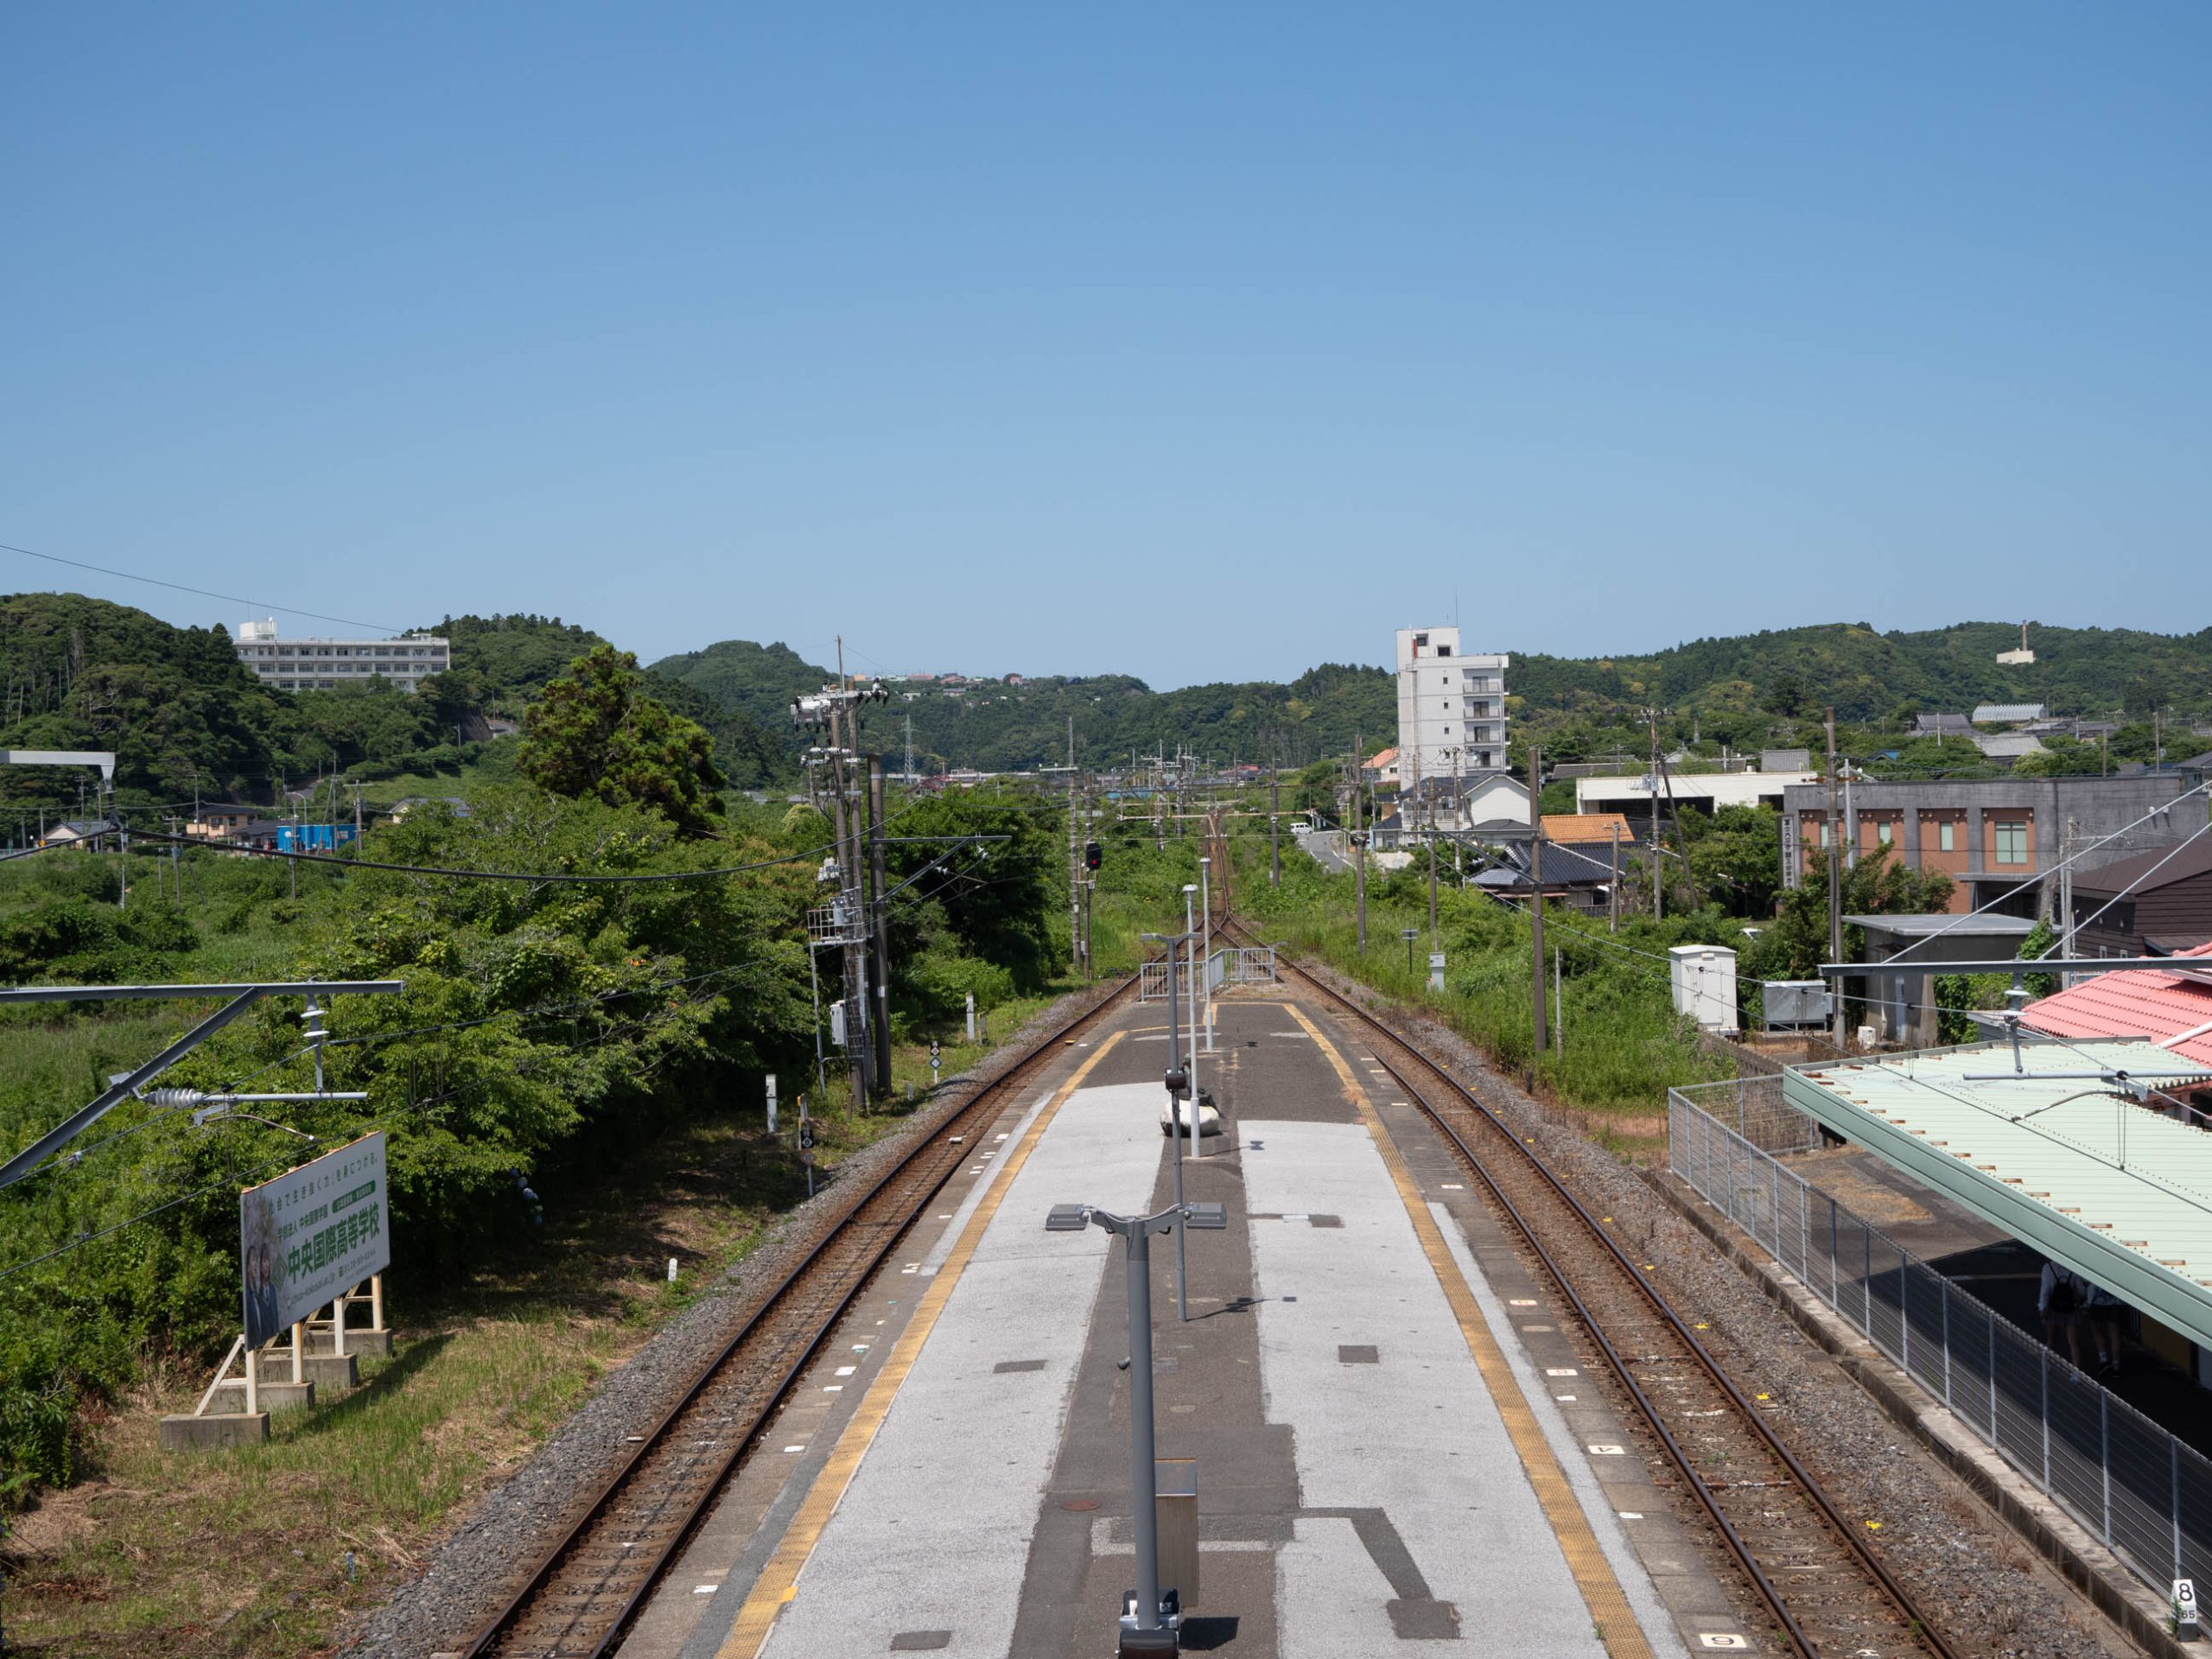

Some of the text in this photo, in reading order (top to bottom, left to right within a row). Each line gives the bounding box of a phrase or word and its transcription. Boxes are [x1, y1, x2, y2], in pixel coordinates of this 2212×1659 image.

[288, 1201, 380, 1286] 中央国際高等学校
[2179, 1583, 2193, 1602] 8
